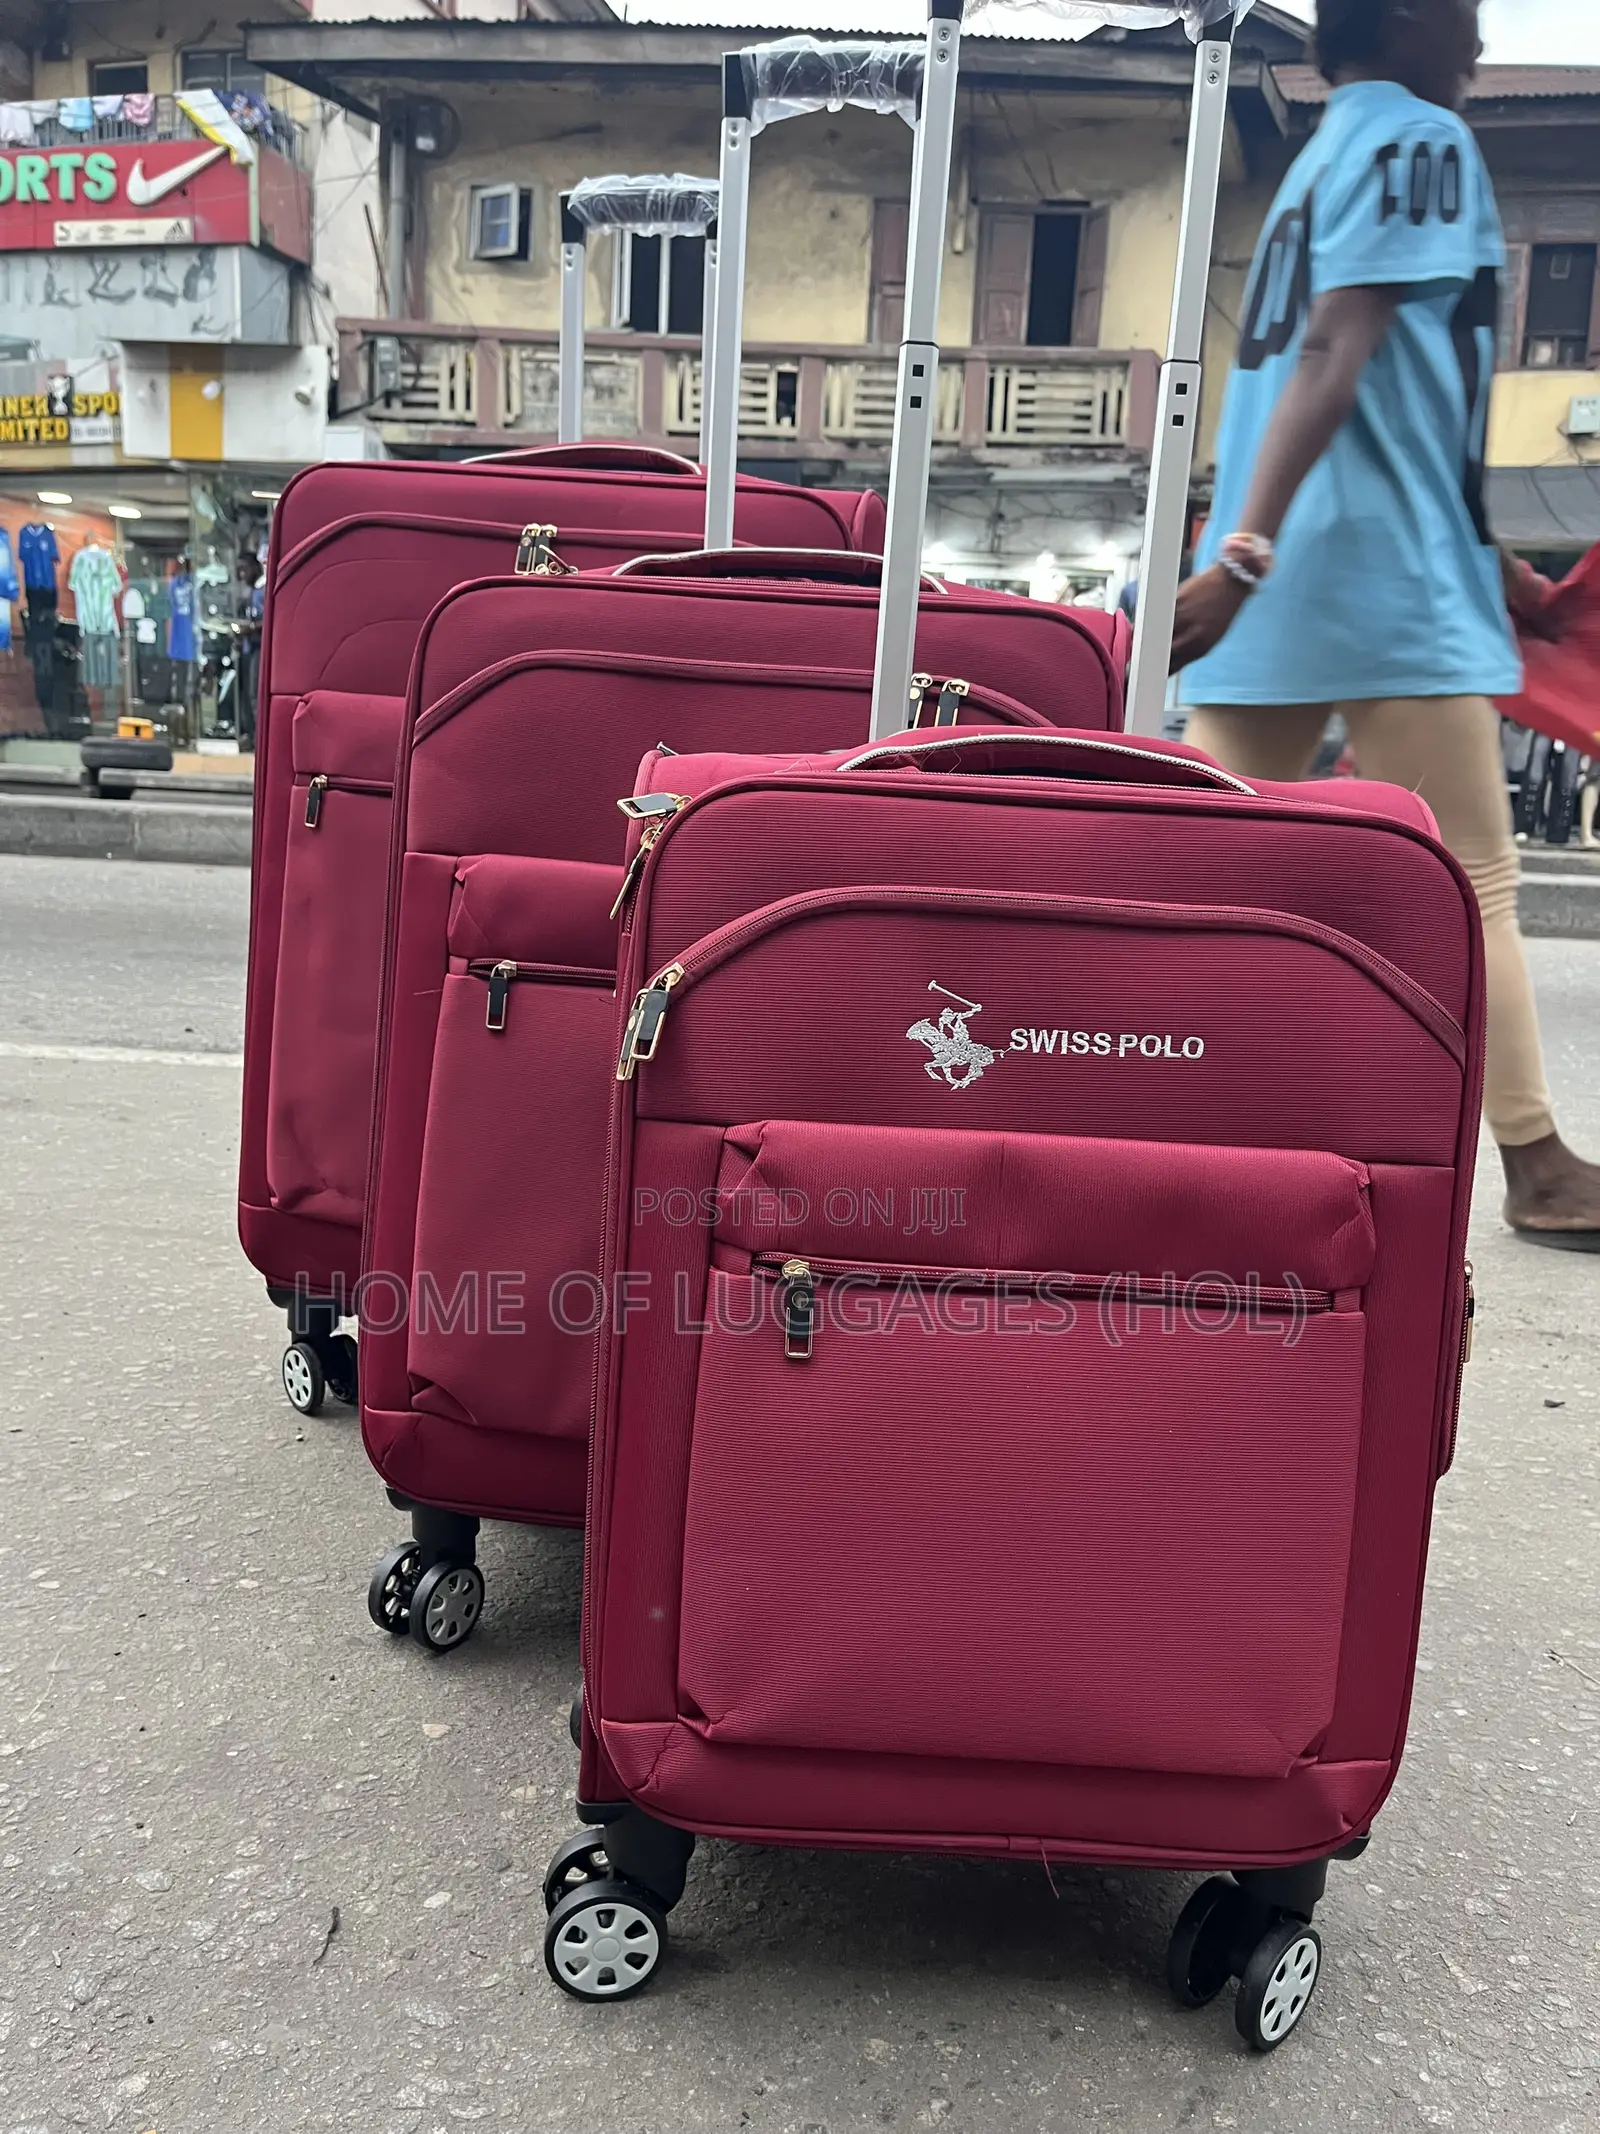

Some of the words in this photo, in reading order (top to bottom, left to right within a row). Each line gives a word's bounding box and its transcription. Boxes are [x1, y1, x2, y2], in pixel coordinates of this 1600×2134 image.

[0, 394, 49, 417] NER
[72, 391, 123, 417] SPO
[1010, 1028, 1112, 1056] SWISS
[1118, 1033, 1205, 1060] POLO
